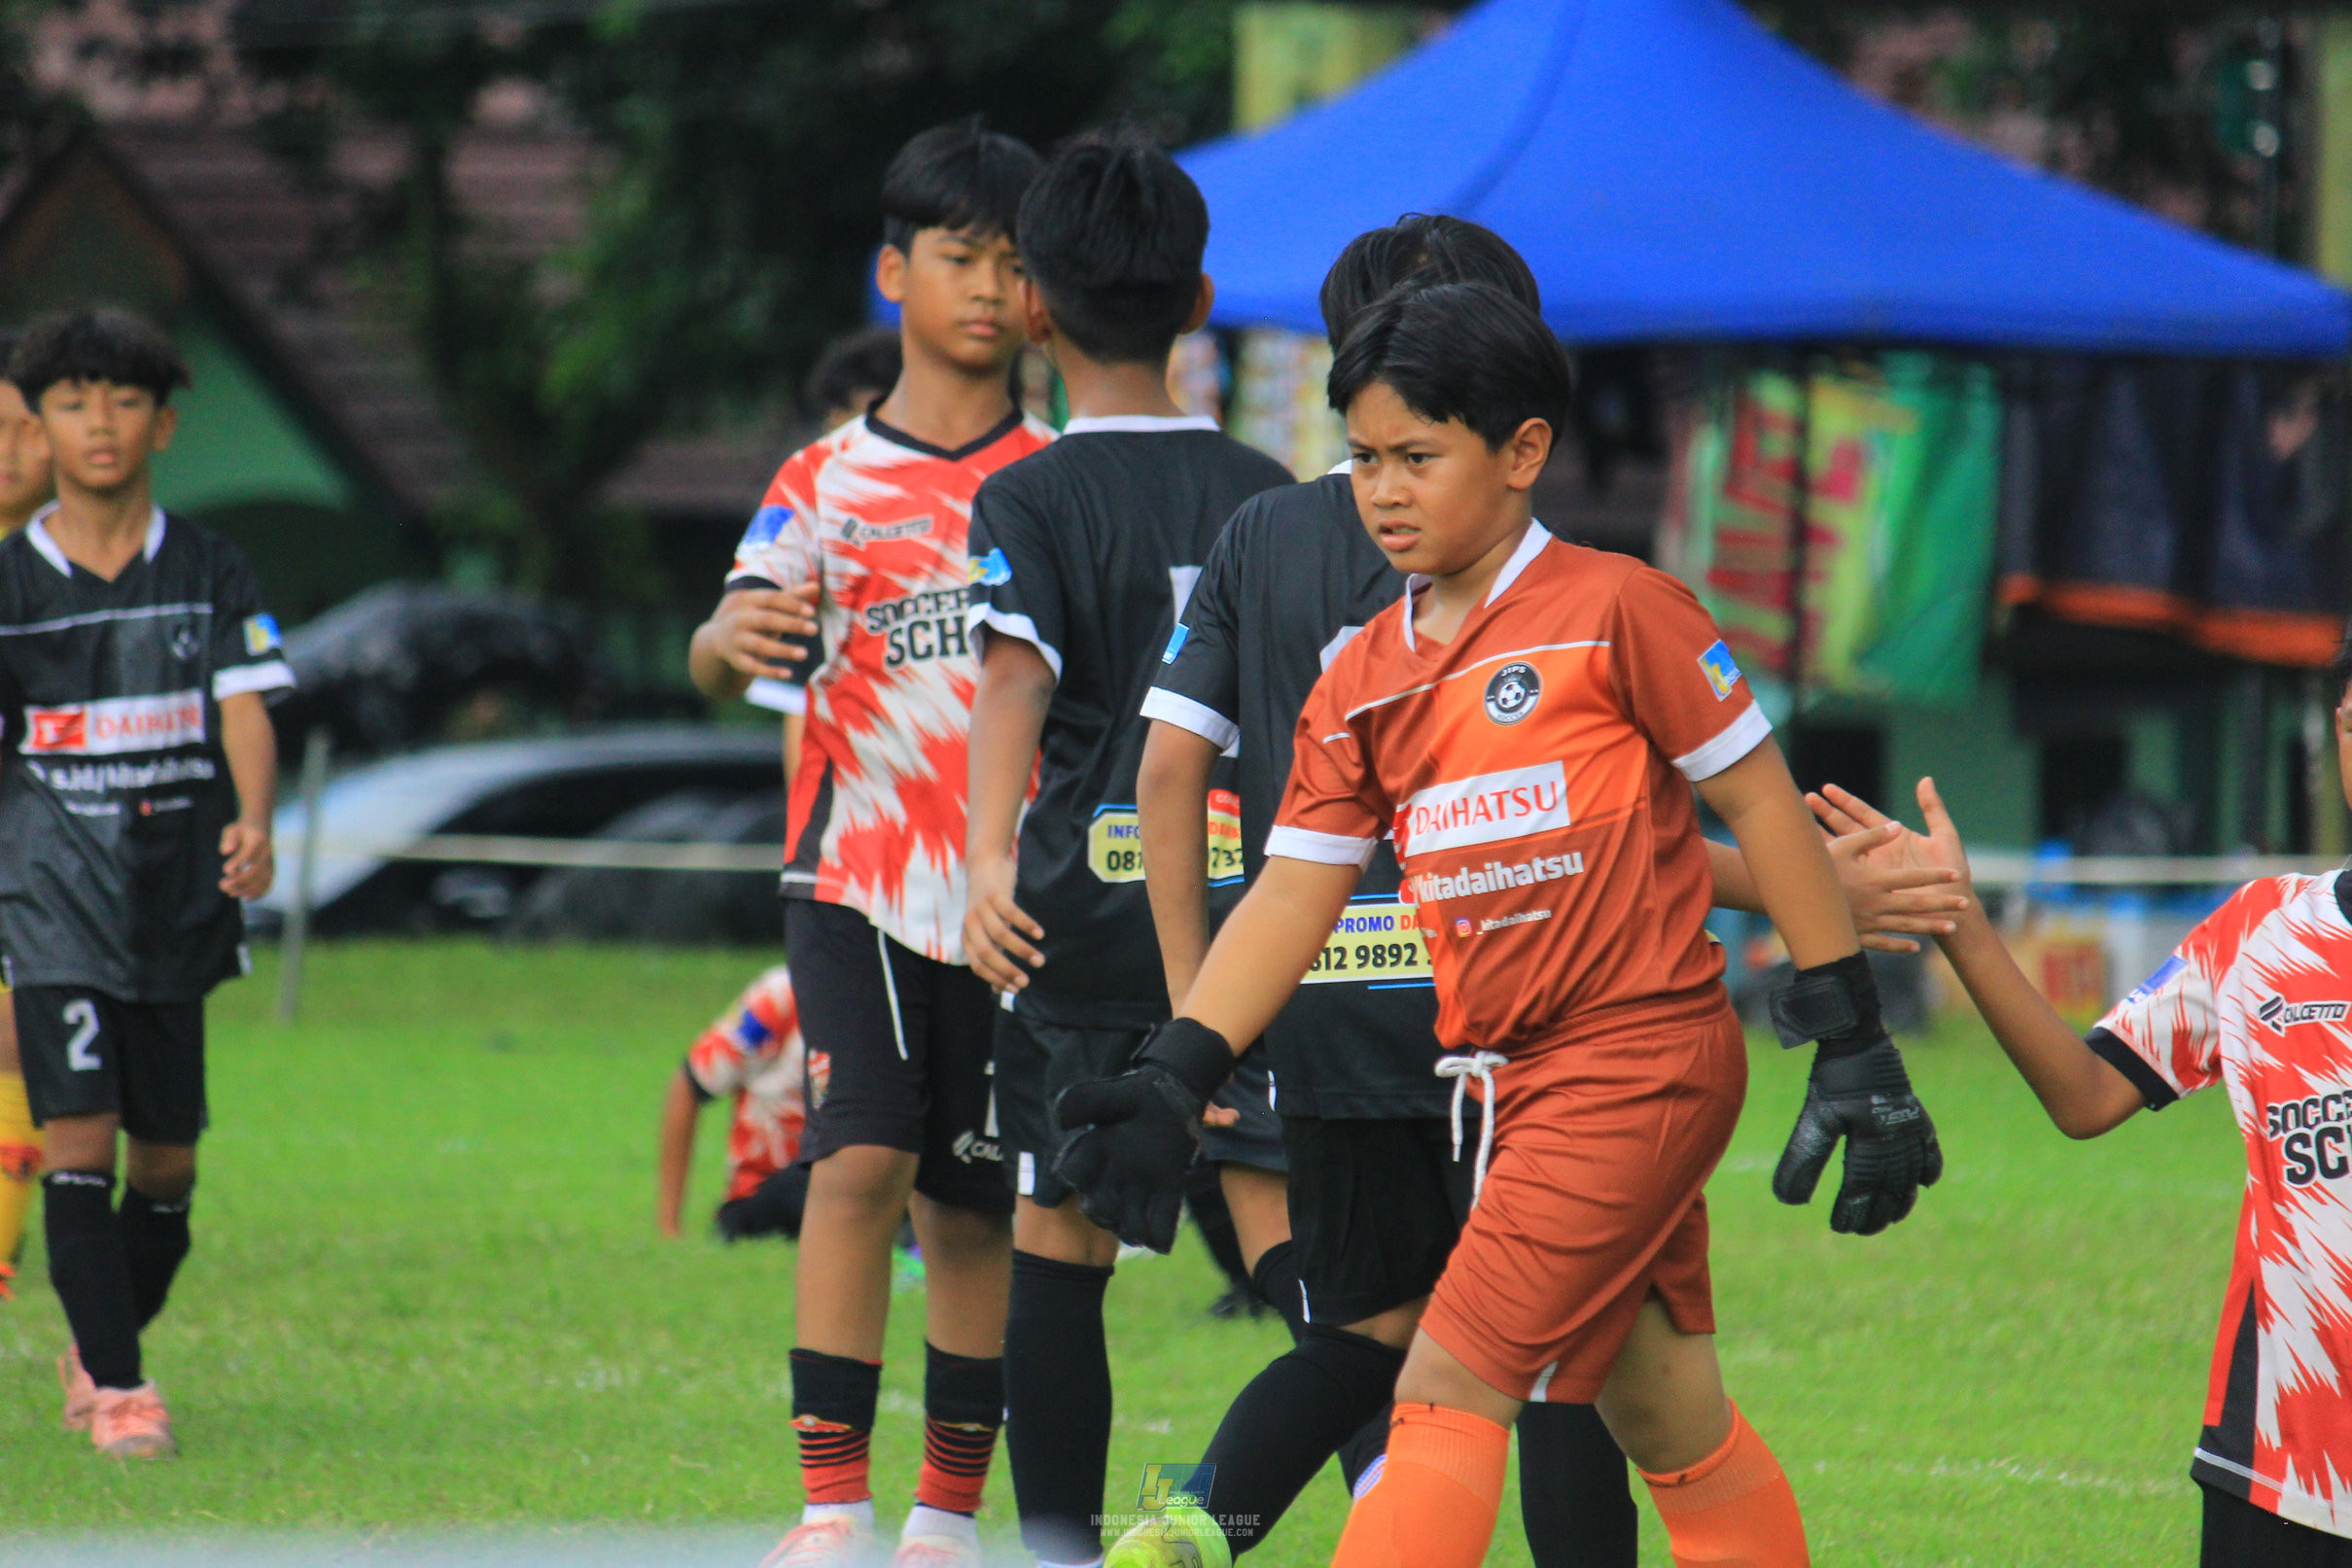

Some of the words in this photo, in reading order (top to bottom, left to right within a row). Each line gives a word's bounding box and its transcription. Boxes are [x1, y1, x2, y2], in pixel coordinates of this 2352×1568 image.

[866, 589, 970, 631] SOCCER
[1416, 782, 1558, 835] DAIHATSU
[1333, 916, 1394, 933] PROMO
[1354, 943, 1418, 969] 9892
[64, 999, 101, 1070] 2
